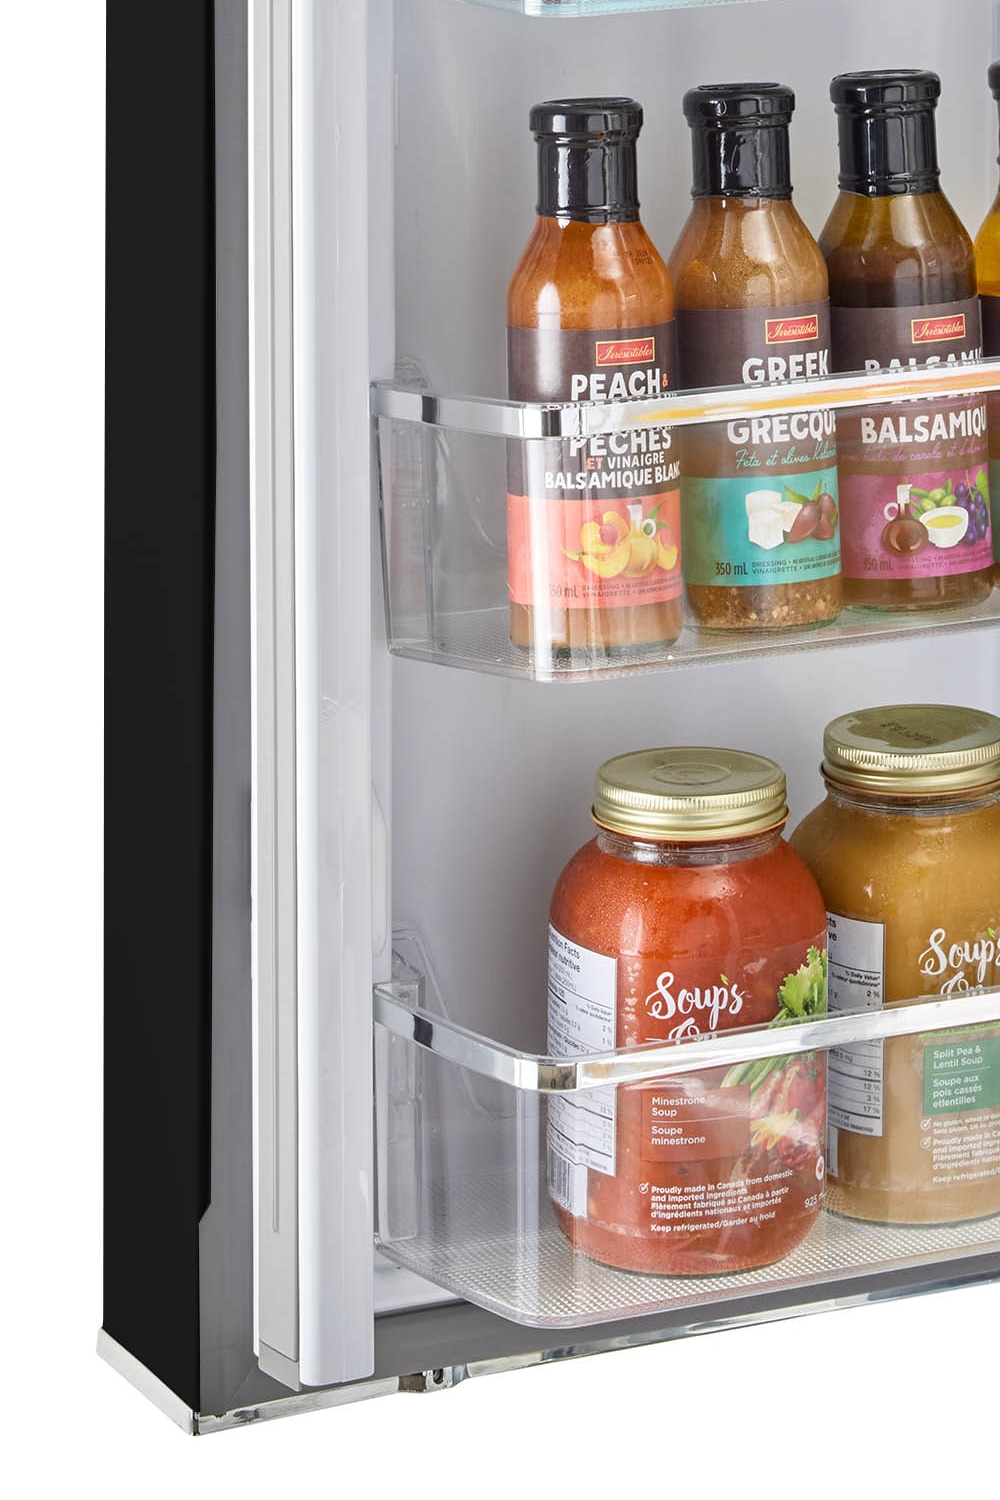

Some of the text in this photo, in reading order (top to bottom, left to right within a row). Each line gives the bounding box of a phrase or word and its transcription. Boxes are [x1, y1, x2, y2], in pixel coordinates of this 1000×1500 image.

[742, 348, 829, 385] GREEK
[571, 368, 669, 401] PEACH &
[586, 451, 665, 470] ET VINAIGRE
[544, 468, 652, 490] BALSAMIQUE
[715, 562, 731, 576] 350
[733, 562, 748, 576] mL
[751, 558, 787, 567] DRESSING
[933, 1047, 954, 1060] Split
[956, 1046, 974, 1056] Pea
[933, 1056, 983, 1069] Lentil Soup
[933, 1075, 979, 1088] Soupe aux
[932, 1088, 952, 1099] pois
[651, 1096, 706, 1106] Minestrone
[651, 1107, 678, 1118] Soup
[651, 1126, 683, 1136] Soupe
[651, 1135, 706, 1146] minestrone
[651, 1186, 682, 1195] Proudly
[684, 1184, 706, 1194] made
[716, 1180, 745, 1190] Canada
[745, 1176, 763, 1186] from
[763, 1169, 793, 1182] domestic
[651, 1194, 665, 1202] and
[668, 1191, 704, 1204] imported
[737, 1192, 764, 1204] Canada
[771, 1186, 789, 1198] partir
[804, 1196, 818, 1208] 925
[704, 1206, 741, 1216] nationaux
[742, 1203, 751, 1211] et
[751, 1196, 782, 1209] importés
[651, 1223, 672, 1233] Keep
[673, 1216, 747, 1232] refrigerated/Garder
[759, 1211, 776, 1222] froid
